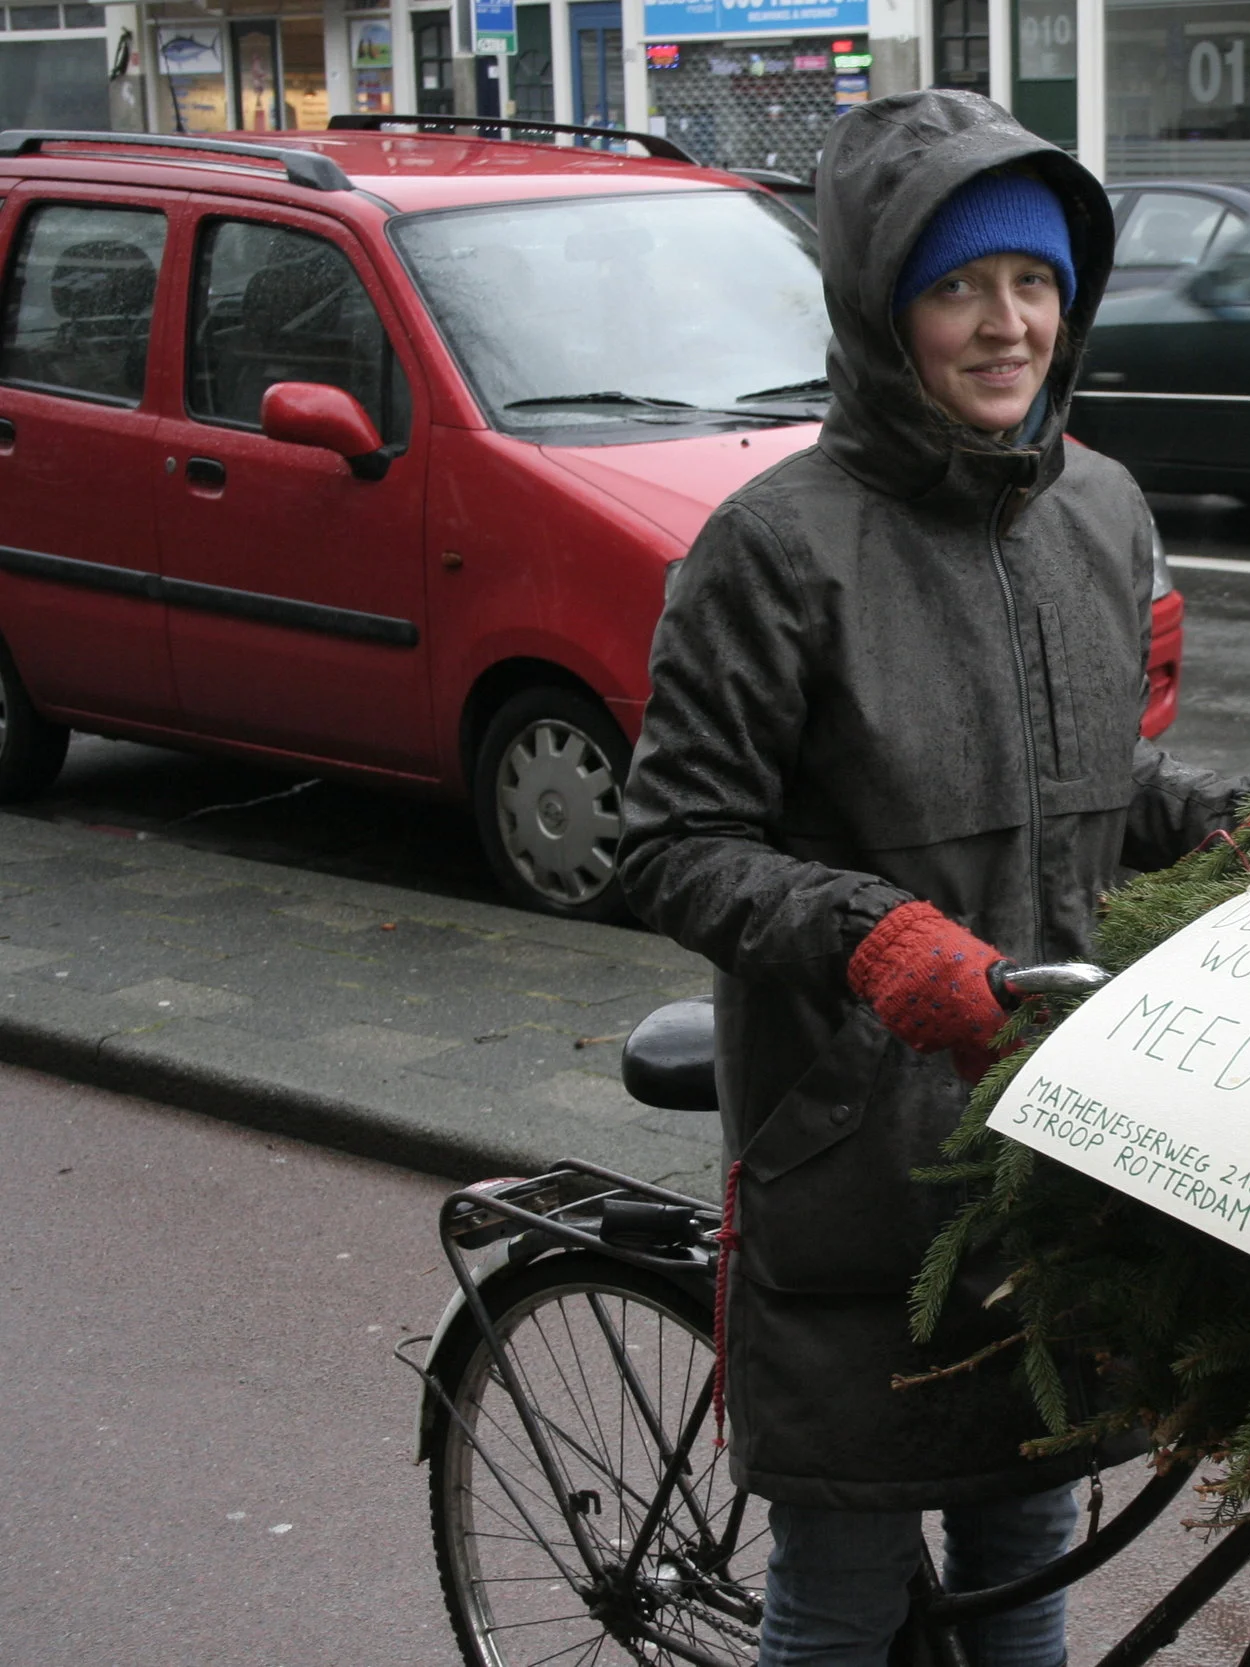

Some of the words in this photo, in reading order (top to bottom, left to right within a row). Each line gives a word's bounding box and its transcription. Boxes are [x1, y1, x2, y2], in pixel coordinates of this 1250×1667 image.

[1021, 15, 1072, 47] 010
[1012, 1103, 1105, 1152] STROOP
[1026, 1075, 1211, 1174] MATHENESSERWEG
